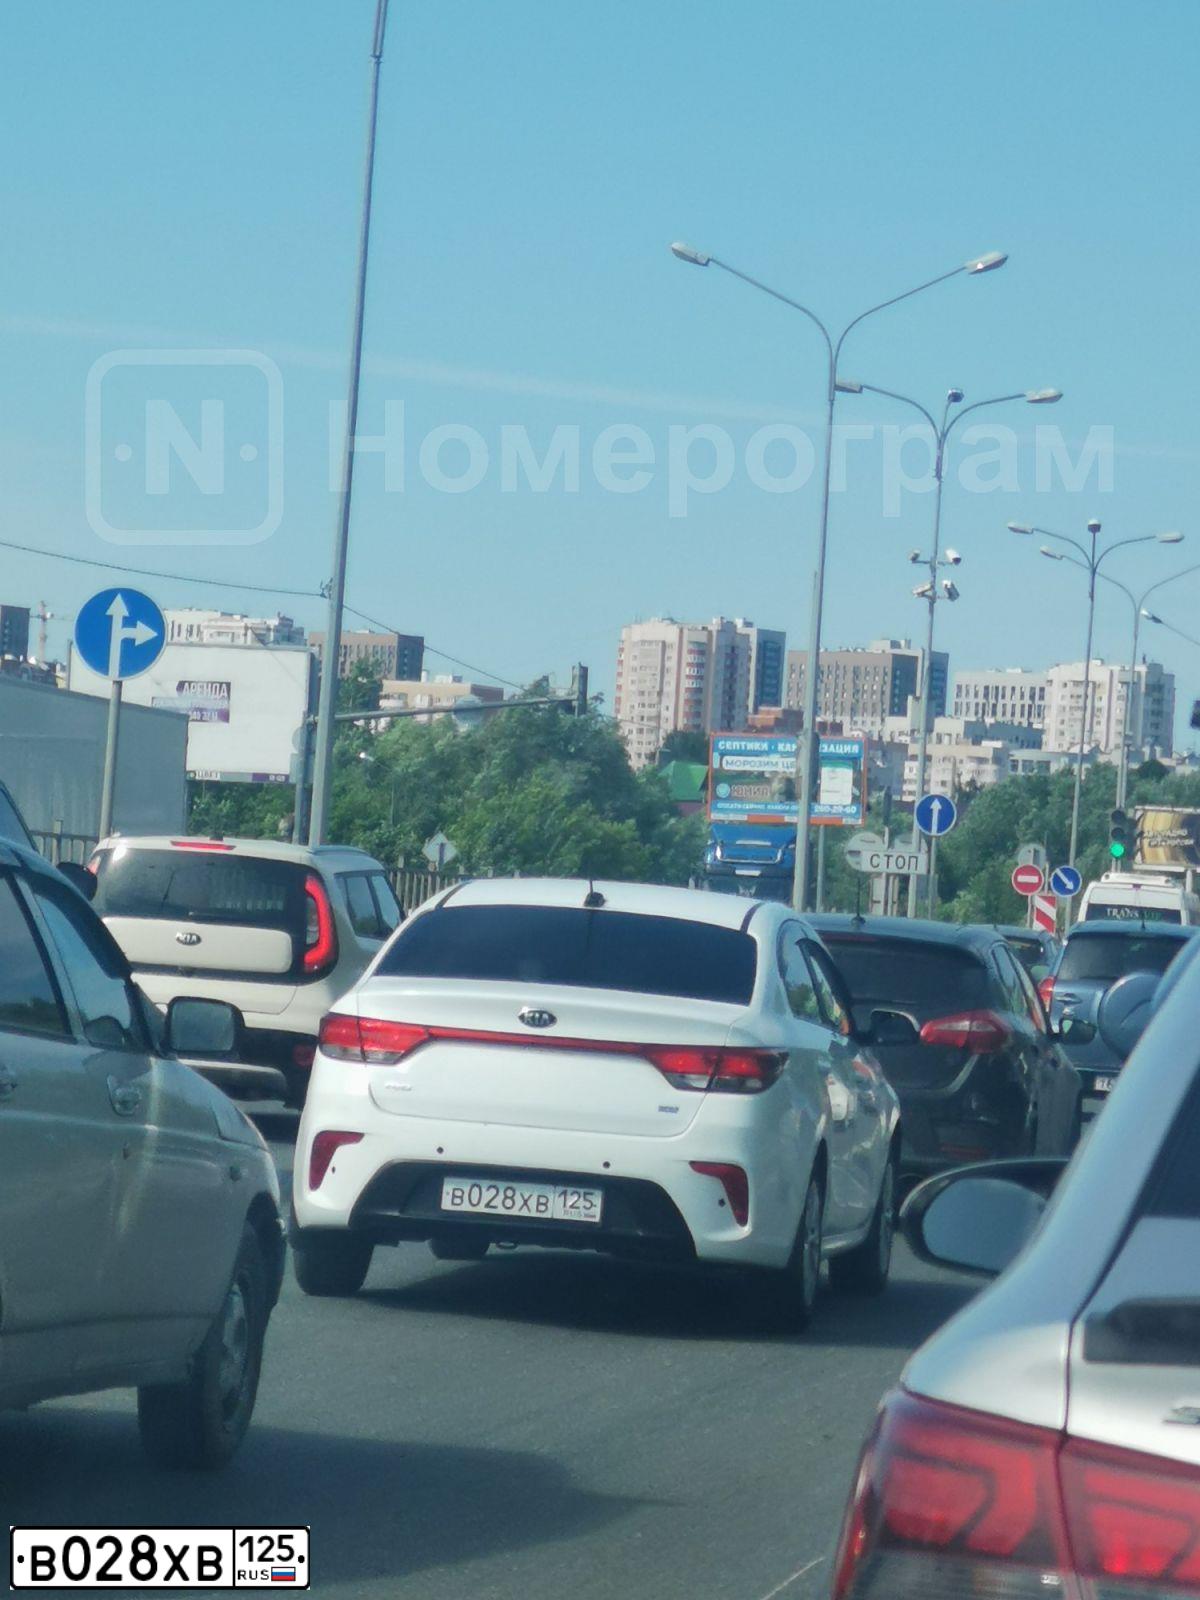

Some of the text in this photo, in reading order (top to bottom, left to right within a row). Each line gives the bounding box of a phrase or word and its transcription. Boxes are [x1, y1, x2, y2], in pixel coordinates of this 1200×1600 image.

[182, 682, 228, 699] АРЕНДА
[718, 740, 768, 751] СЕПТИКИ
[725, 758, 779, 769] МОРОЗИМ
[869, 854, 919, 871] СТОП
[1106, 907, 1140, 919] TRANS
[522, 1011, 551, 1026] KIA
[450, 1183, 594, 1214] В028ХВ 125
